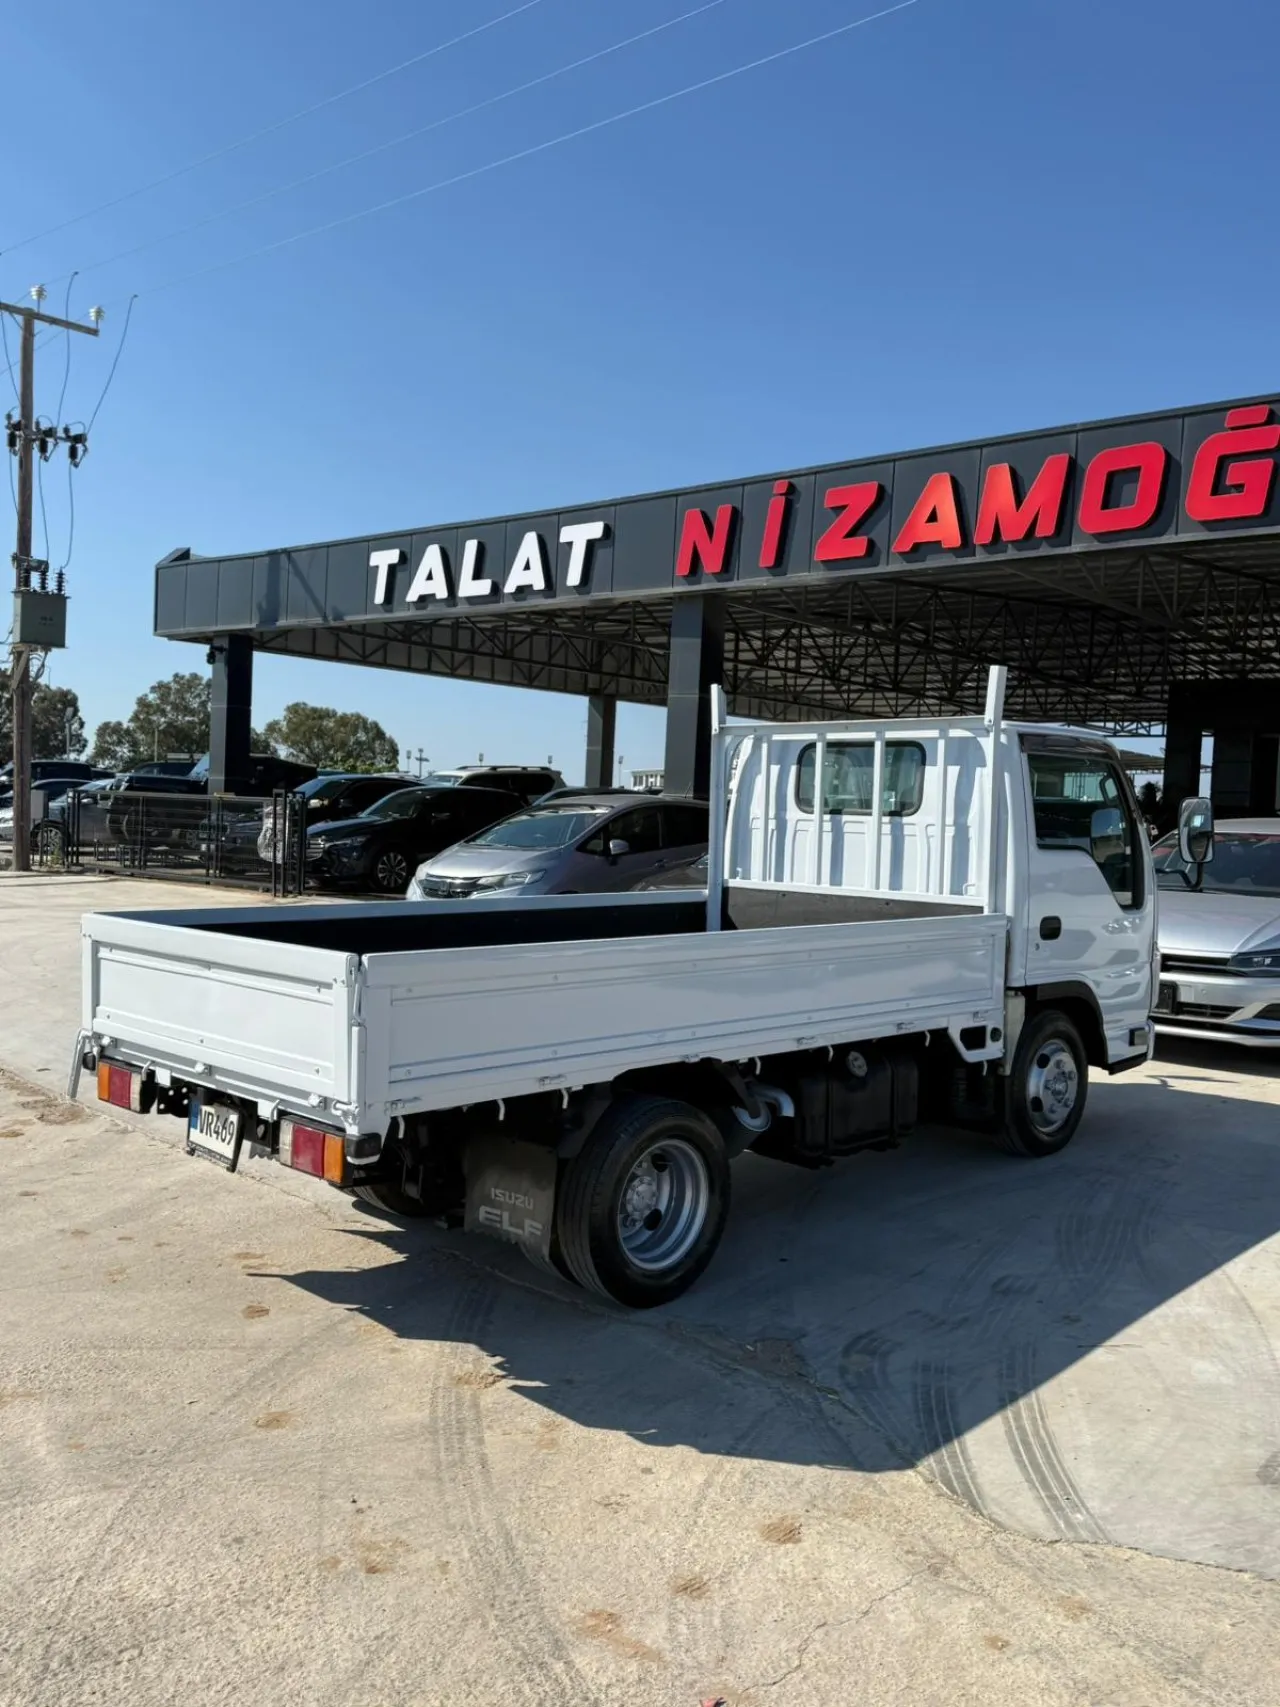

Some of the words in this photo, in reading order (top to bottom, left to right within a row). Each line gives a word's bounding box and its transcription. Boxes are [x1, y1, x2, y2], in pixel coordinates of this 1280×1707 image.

[369, 521, 605, 605] TALAT
[675, 403, 1280, 576] NİZAMOĞ
[199, 1106, 235, 1146] VR469
[491, 1187, 534, 1210] ISUZU
[479, 1205, 543, 1237] ELF
